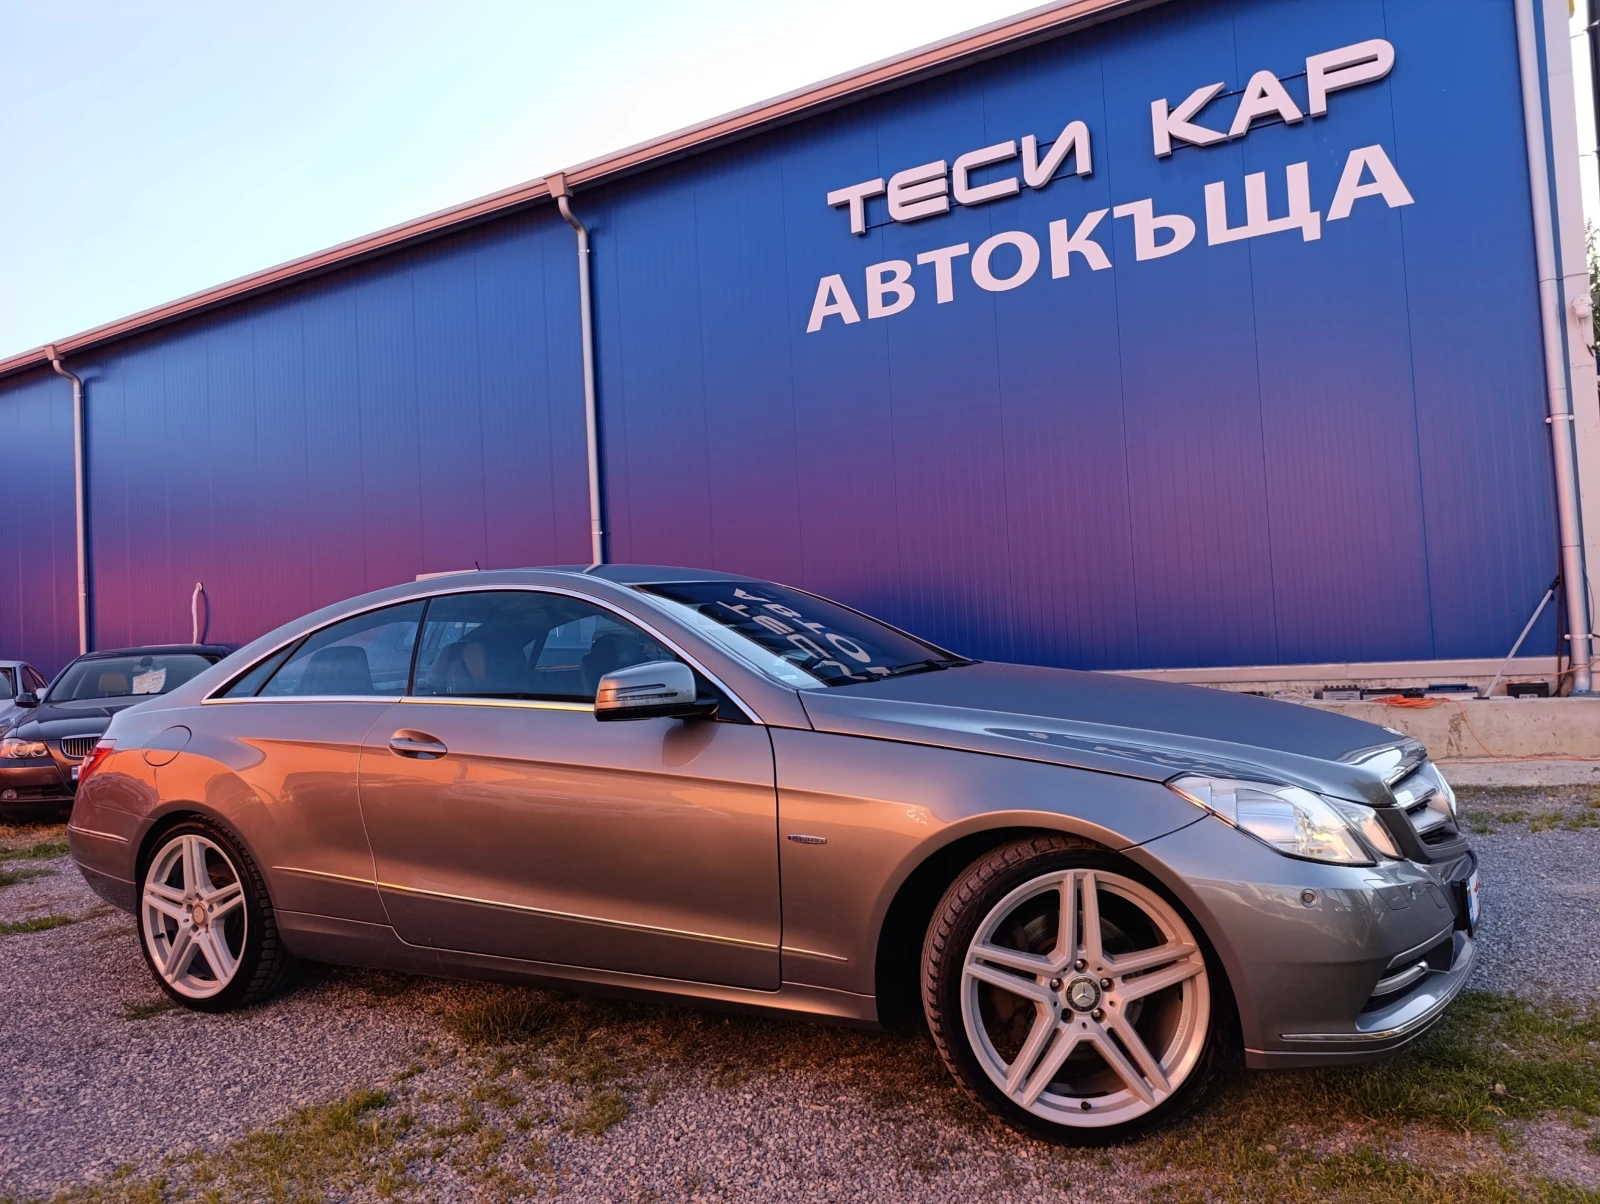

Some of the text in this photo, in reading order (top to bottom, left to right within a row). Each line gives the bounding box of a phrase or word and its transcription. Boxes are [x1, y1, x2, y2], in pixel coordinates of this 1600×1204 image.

[827, 38, 1396, 236] ТЕСИ КАР
[806, 143, 1415, 334] АВТОКЪЩА
